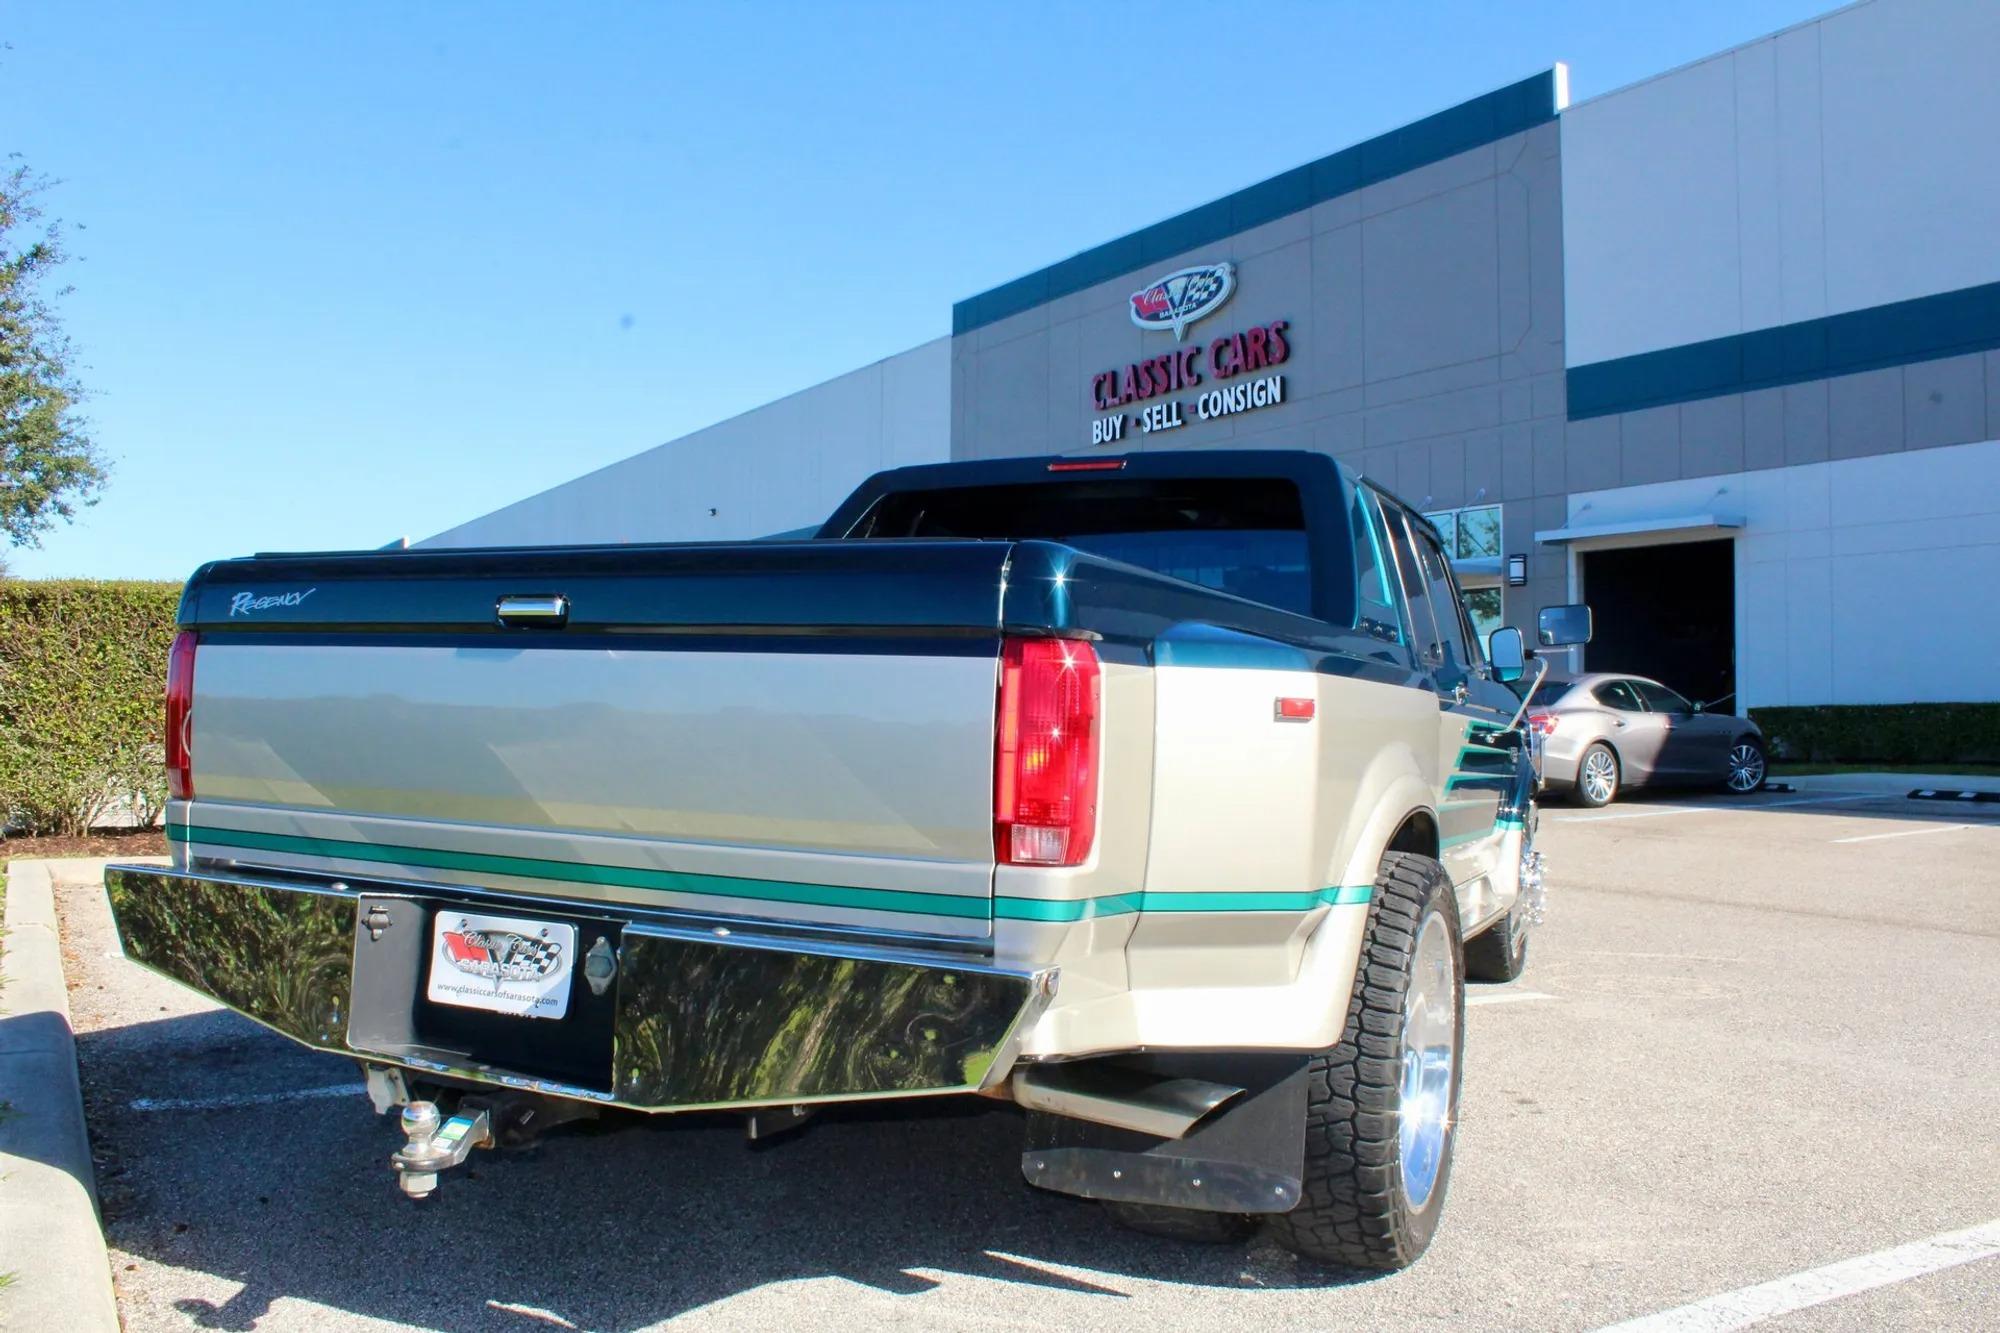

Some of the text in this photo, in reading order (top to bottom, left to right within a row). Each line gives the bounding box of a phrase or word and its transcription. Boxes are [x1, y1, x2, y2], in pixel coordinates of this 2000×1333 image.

[1091, 320, 1288, 411] CLASSIC CARS
[1092, 375, 1283, 444] BUY SELL CONSIGN
[437, 982, 559, 1008] www.classiccarsofsarasota.com
